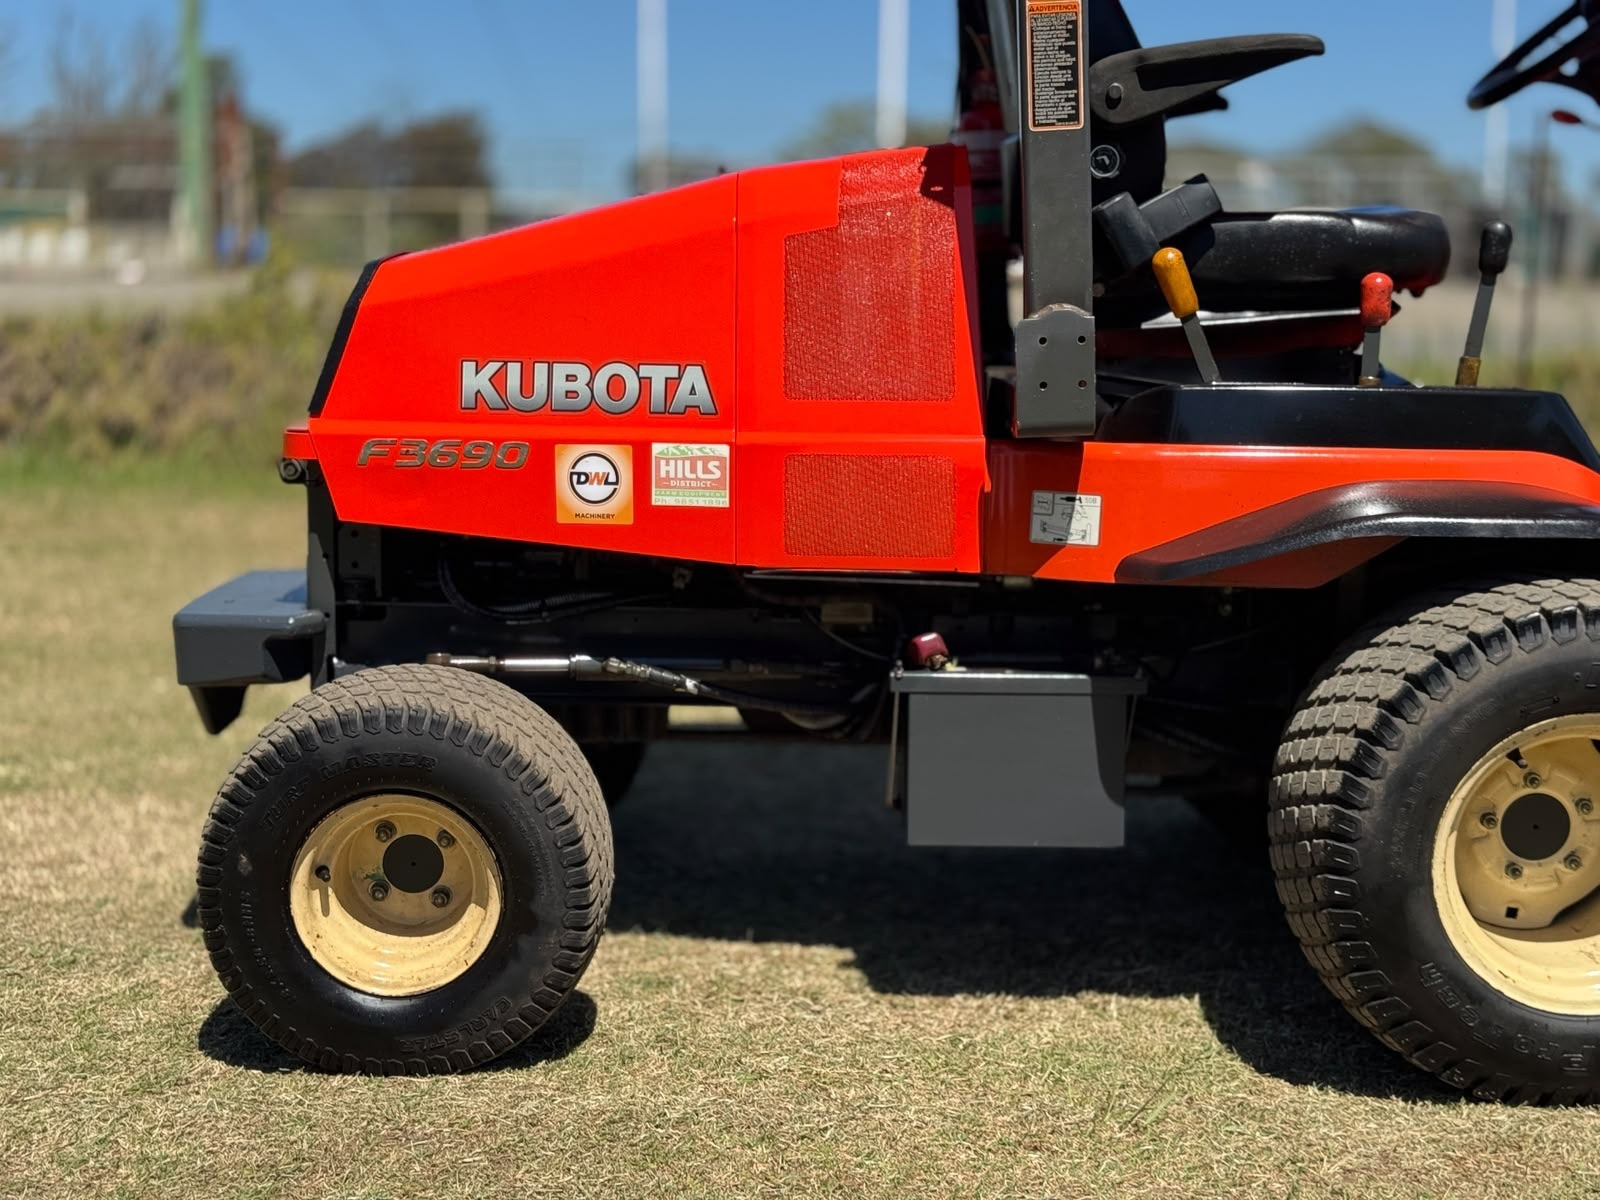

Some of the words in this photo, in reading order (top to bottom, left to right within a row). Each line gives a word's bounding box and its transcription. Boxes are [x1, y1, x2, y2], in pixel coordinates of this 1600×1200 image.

[460, 360, 719, 416] KUBOTA
[356, 438, 531, 470] F3690
[570, 471, 620, 486] DWL
[660, 459, 721, 479] HILLS
[670, 480, 712, 488] DISTRICT
[574, 512, 616, 520] MACHINERY
[320, 752, 438, 784] MASTER
